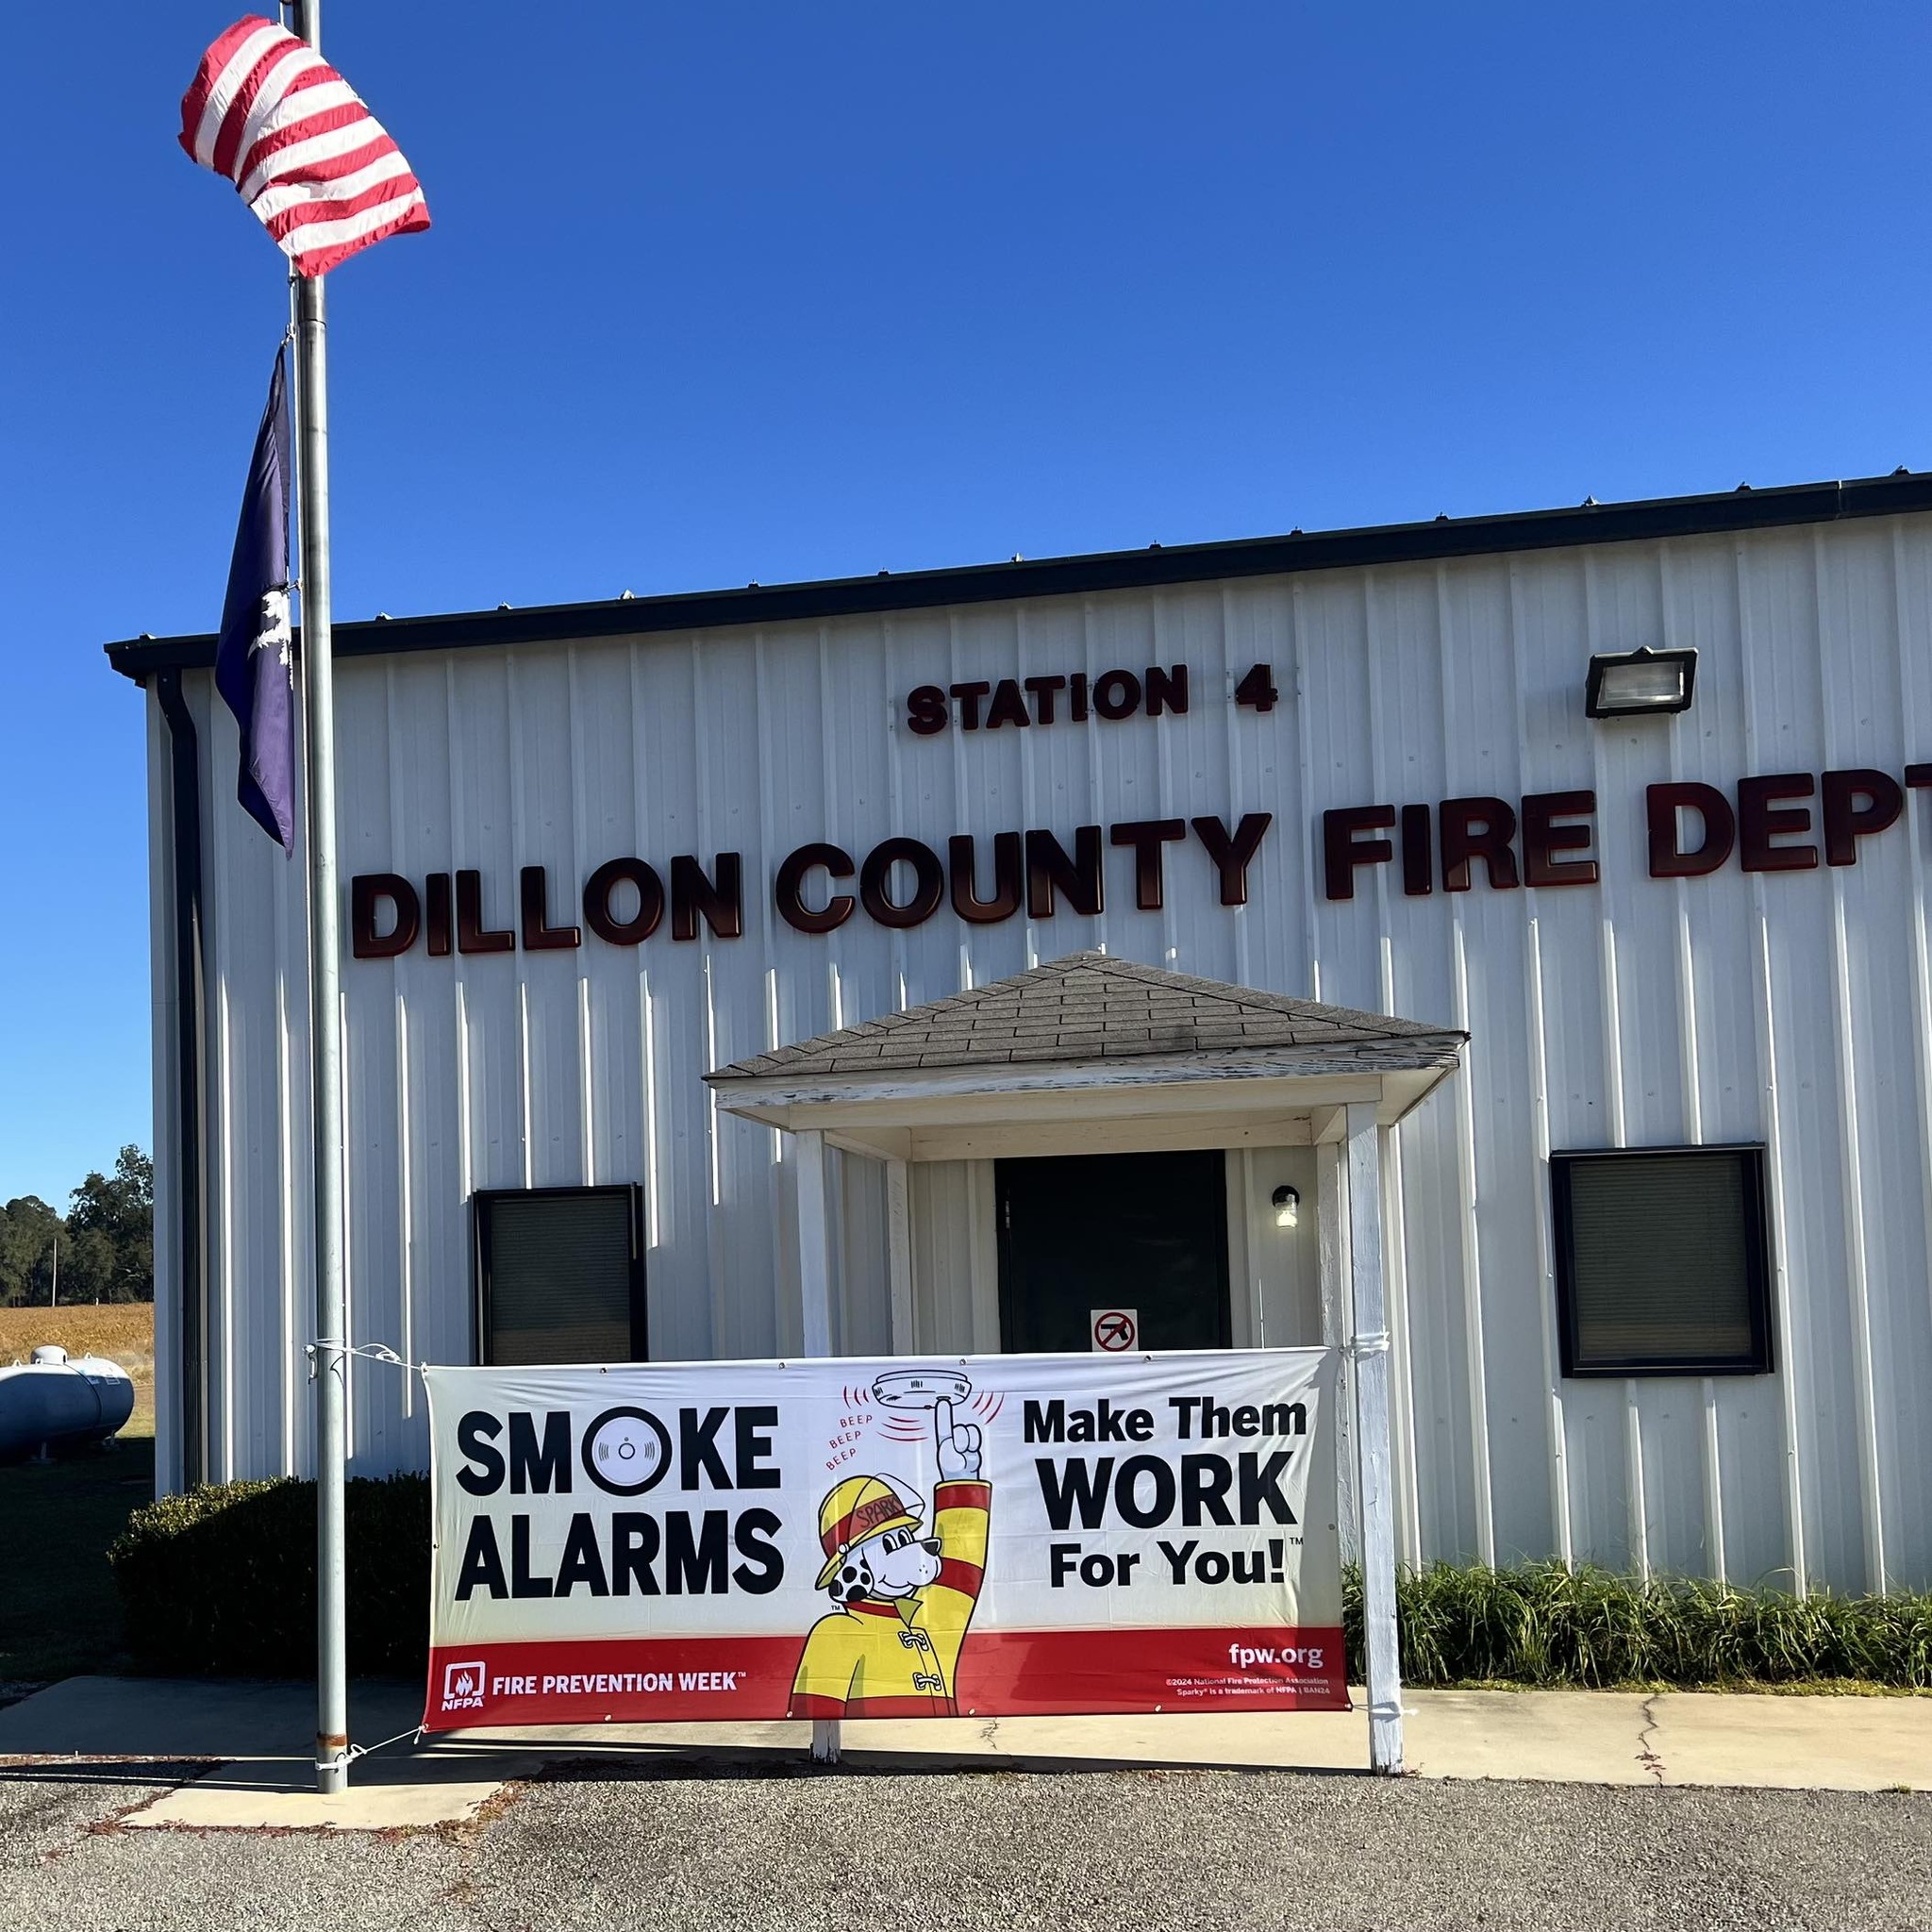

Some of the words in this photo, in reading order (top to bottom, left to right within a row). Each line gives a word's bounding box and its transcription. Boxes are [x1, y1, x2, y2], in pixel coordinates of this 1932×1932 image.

[907, 664, 1189, 735] STATION
[1236, 663, 1279, 712] 4
[352, 852, 741, 959] DILLON
[775, 812, 1273, 934] COUNTY
[1323, 790, 1598, 900] FIRE
[840, 1414, 873, 1428] BEEP
[1024, 1398, 1155, 1443] Make
[1169, 1396, 1307, 1440] Them
[456, 1406, 782, 1497] SMOKE
[829, 1430, 861, 1449] BEEP
[825, 1447, 857, 1471] BEEP
[1035, 1451, 1298, 1530] WORK
[455, 1507, 785, 1601] ALARMS
[1050, 1542, 1141, 1588] For
[1156, 1539, 1284, 1585] You!
[1228, 1643, 1324, 1669] fpw.org
[492, 1675, 537, 1696] FIRE
[542, 1673, 673, 1694] PREVENTION
[1275, 1686, 1297, 1694] NFPA
[1285, 1676, 1328, 1685] Association
[441, 1697, 484, 1711] NFPA
